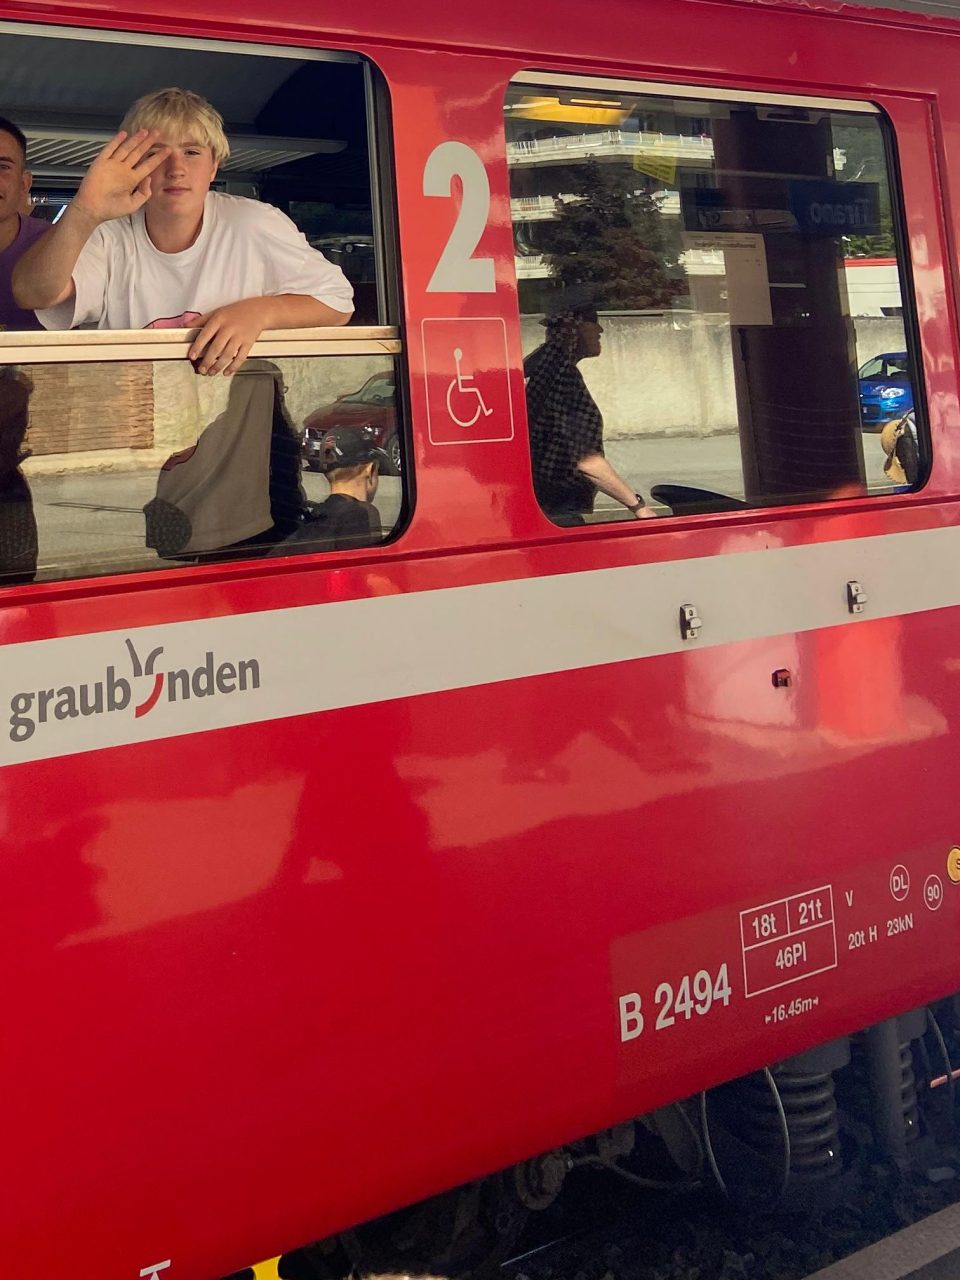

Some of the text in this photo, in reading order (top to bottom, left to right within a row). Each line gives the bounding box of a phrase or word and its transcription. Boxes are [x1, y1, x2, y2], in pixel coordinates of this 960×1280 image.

[422, 140, 497, 293] 2
[892, 873, 909, 893] DL
[926, 883, 940, 902] 90
[798, 898, 823, 925] 21t
[844, 889, 854, 908] V
[752, 911, 777, 939] 18t
[847, 913, 914, 950] 20t H 23kN
[618, 962, 732, 1043] B 2494
